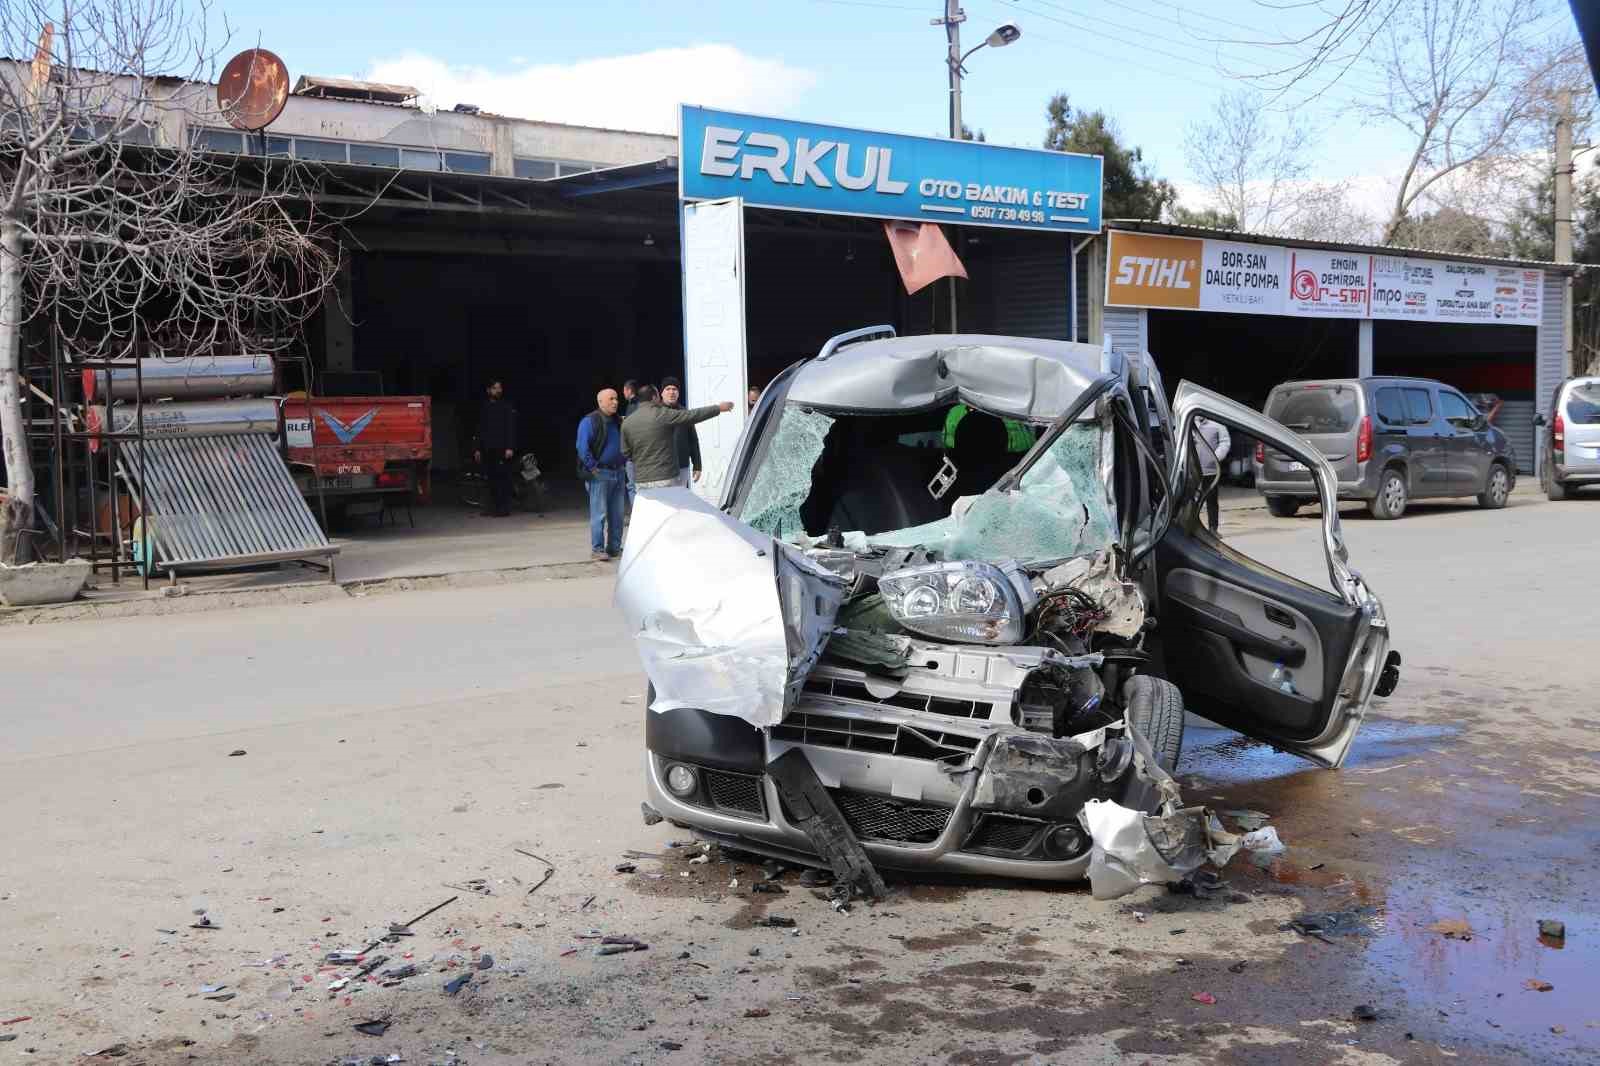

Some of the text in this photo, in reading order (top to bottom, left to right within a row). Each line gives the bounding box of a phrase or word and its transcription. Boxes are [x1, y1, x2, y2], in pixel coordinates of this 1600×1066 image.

[700, 125, 910, 195] ERKUL
[919, 178, 1090, 210] OTO BAKIM & TEST
[971, 205, 996, 219] 0507
[1018, 208, 1031, 222] 49
[1114, 255, 1192, 289] STIHL
[1221, 251, 1267, 270] BOR-SAN
[1205, 269, 1279, 290] DALGIÇ POMPA
